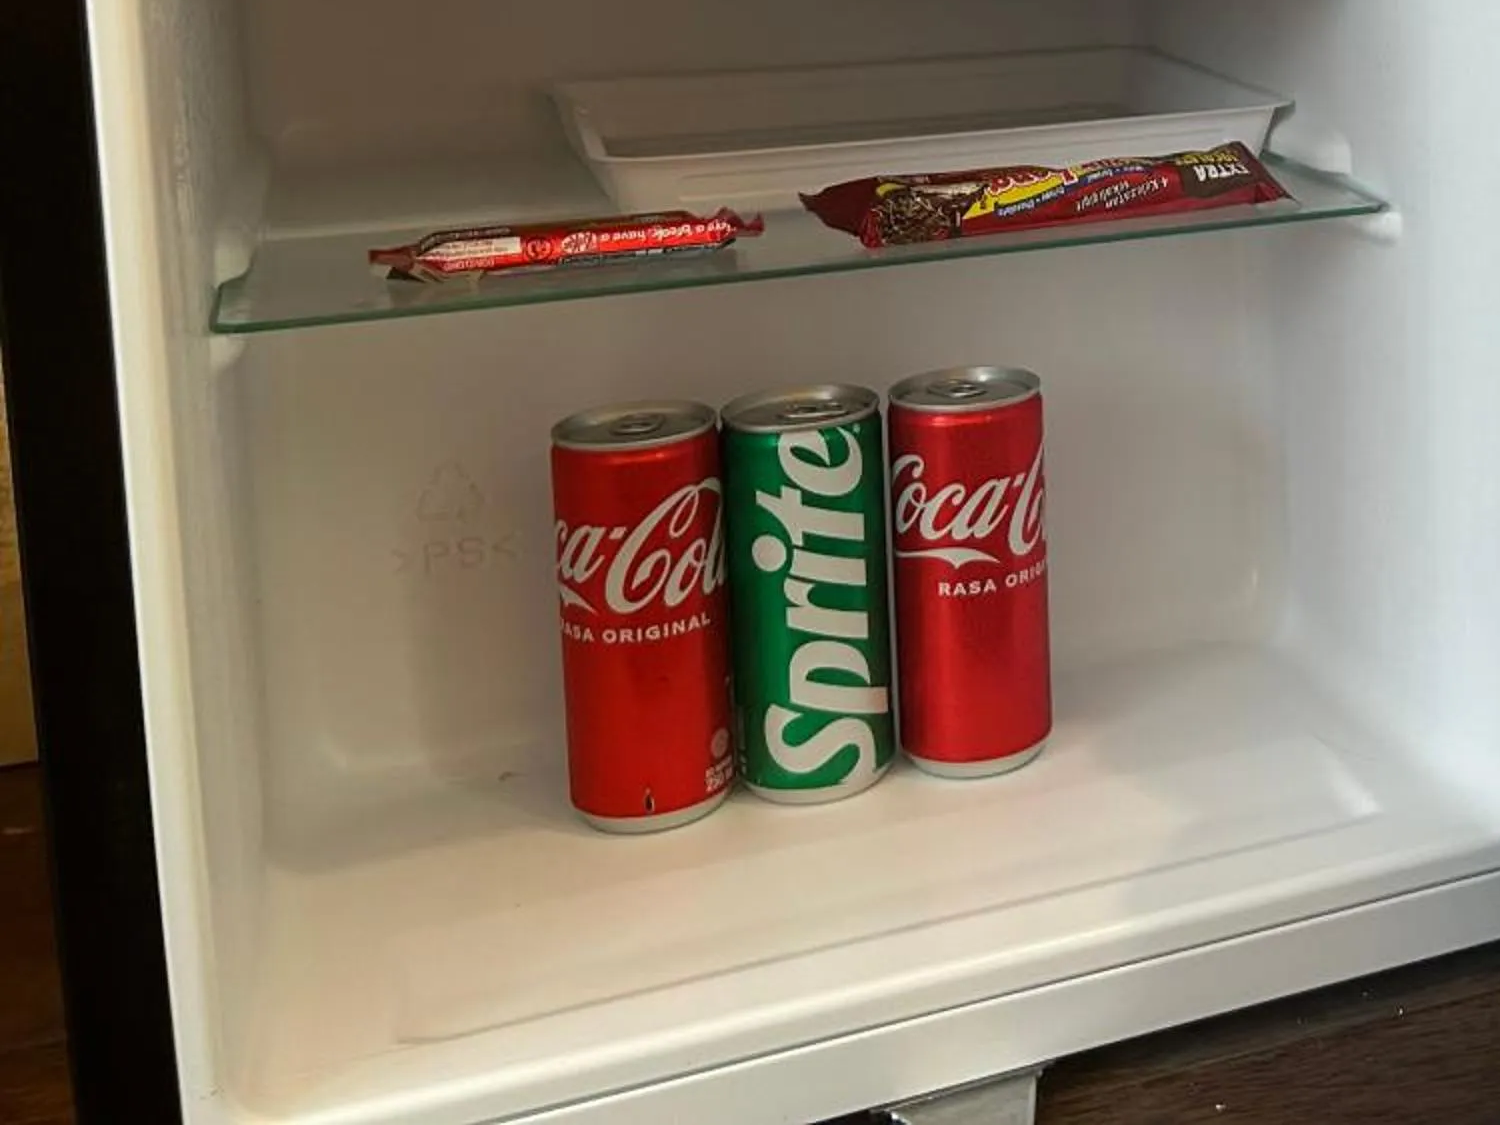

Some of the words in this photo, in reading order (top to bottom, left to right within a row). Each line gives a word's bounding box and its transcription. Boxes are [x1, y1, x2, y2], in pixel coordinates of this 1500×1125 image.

[1193, 162, 1250, 182] EXTRA
[938, 579, 997, 596] RASA
[751, 427, 889, 786] Sprite
[602, 611, 711, 644] ORIGINAL
